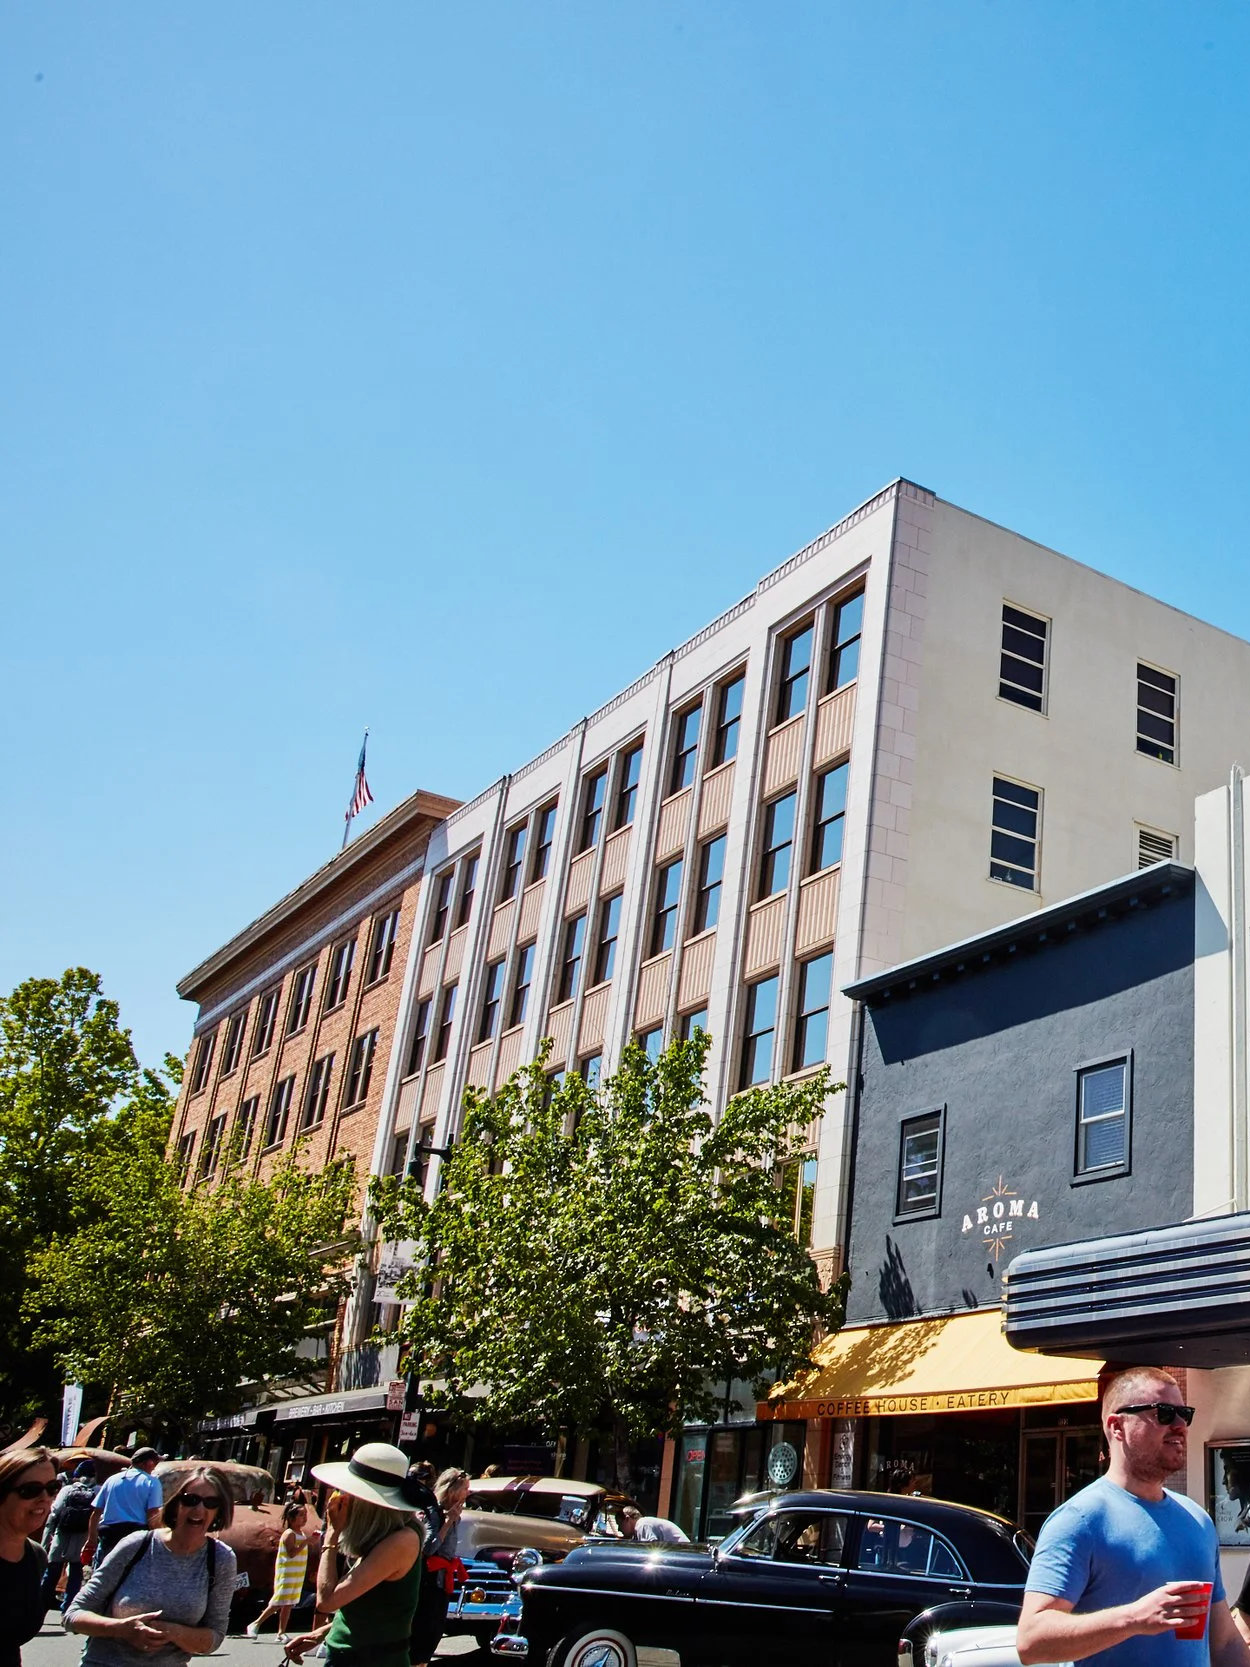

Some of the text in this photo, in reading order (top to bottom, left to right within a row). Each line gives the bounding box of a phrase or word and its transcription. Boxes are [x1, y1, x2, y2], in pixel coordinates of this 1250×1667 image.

[961, 1199, 1039, 1233] AROMA
[983, 1221, 1013, 1235] CAFE
[817, 1391, 1010, 1416] COFFEE HOUSE EATERY
[879, 1459, 915, 1472] AROMA
